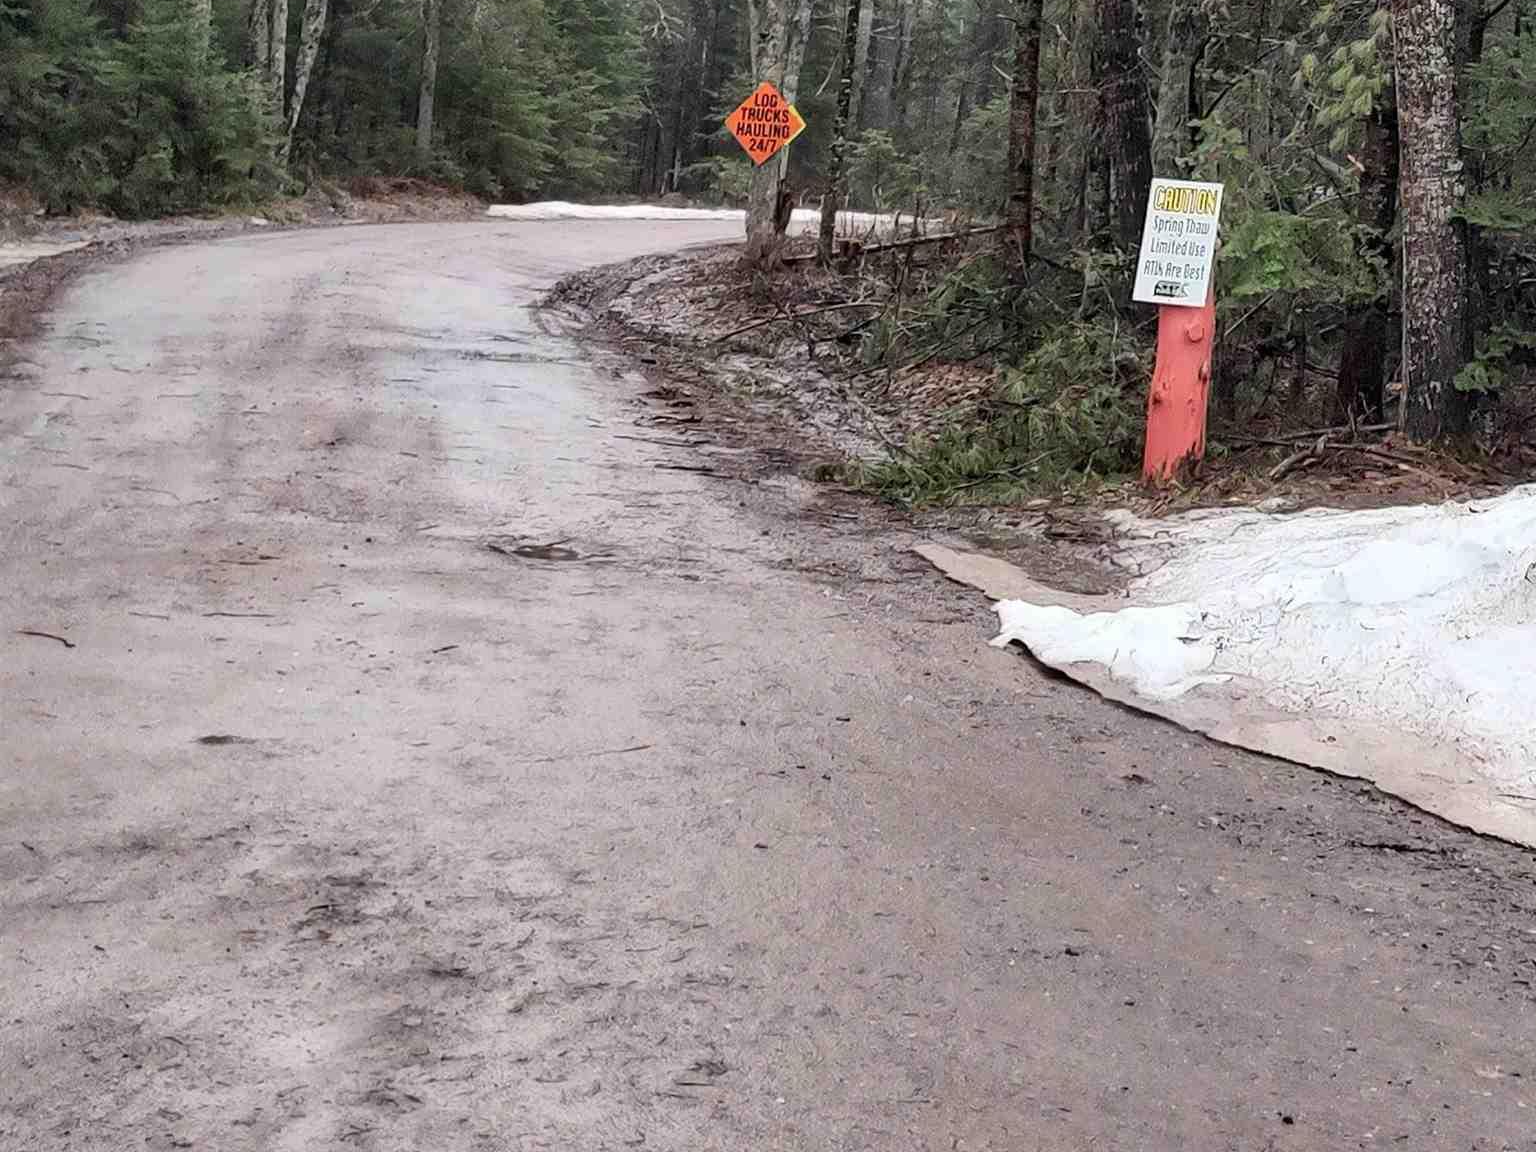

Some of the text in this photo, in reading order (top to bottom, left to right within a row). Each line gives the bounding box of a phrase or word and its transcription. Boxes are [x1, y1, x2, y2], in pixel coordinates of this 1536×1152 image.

[754, 93, 778, 108] LOG
[741, 107, 789, 123] TRUCKS
[736, 122, 790, 139] HAULING
[749, 138, 777, 152] 24/7
[1153, 185, 1218, 216] CAUTION
[1153, 215, 1210, 237] Spring Thaw
[1151, 237, 1205, 257] Limited Use
[1165, 262, 1181, 279] Are
[1184, 263, 1205, 280] Best
